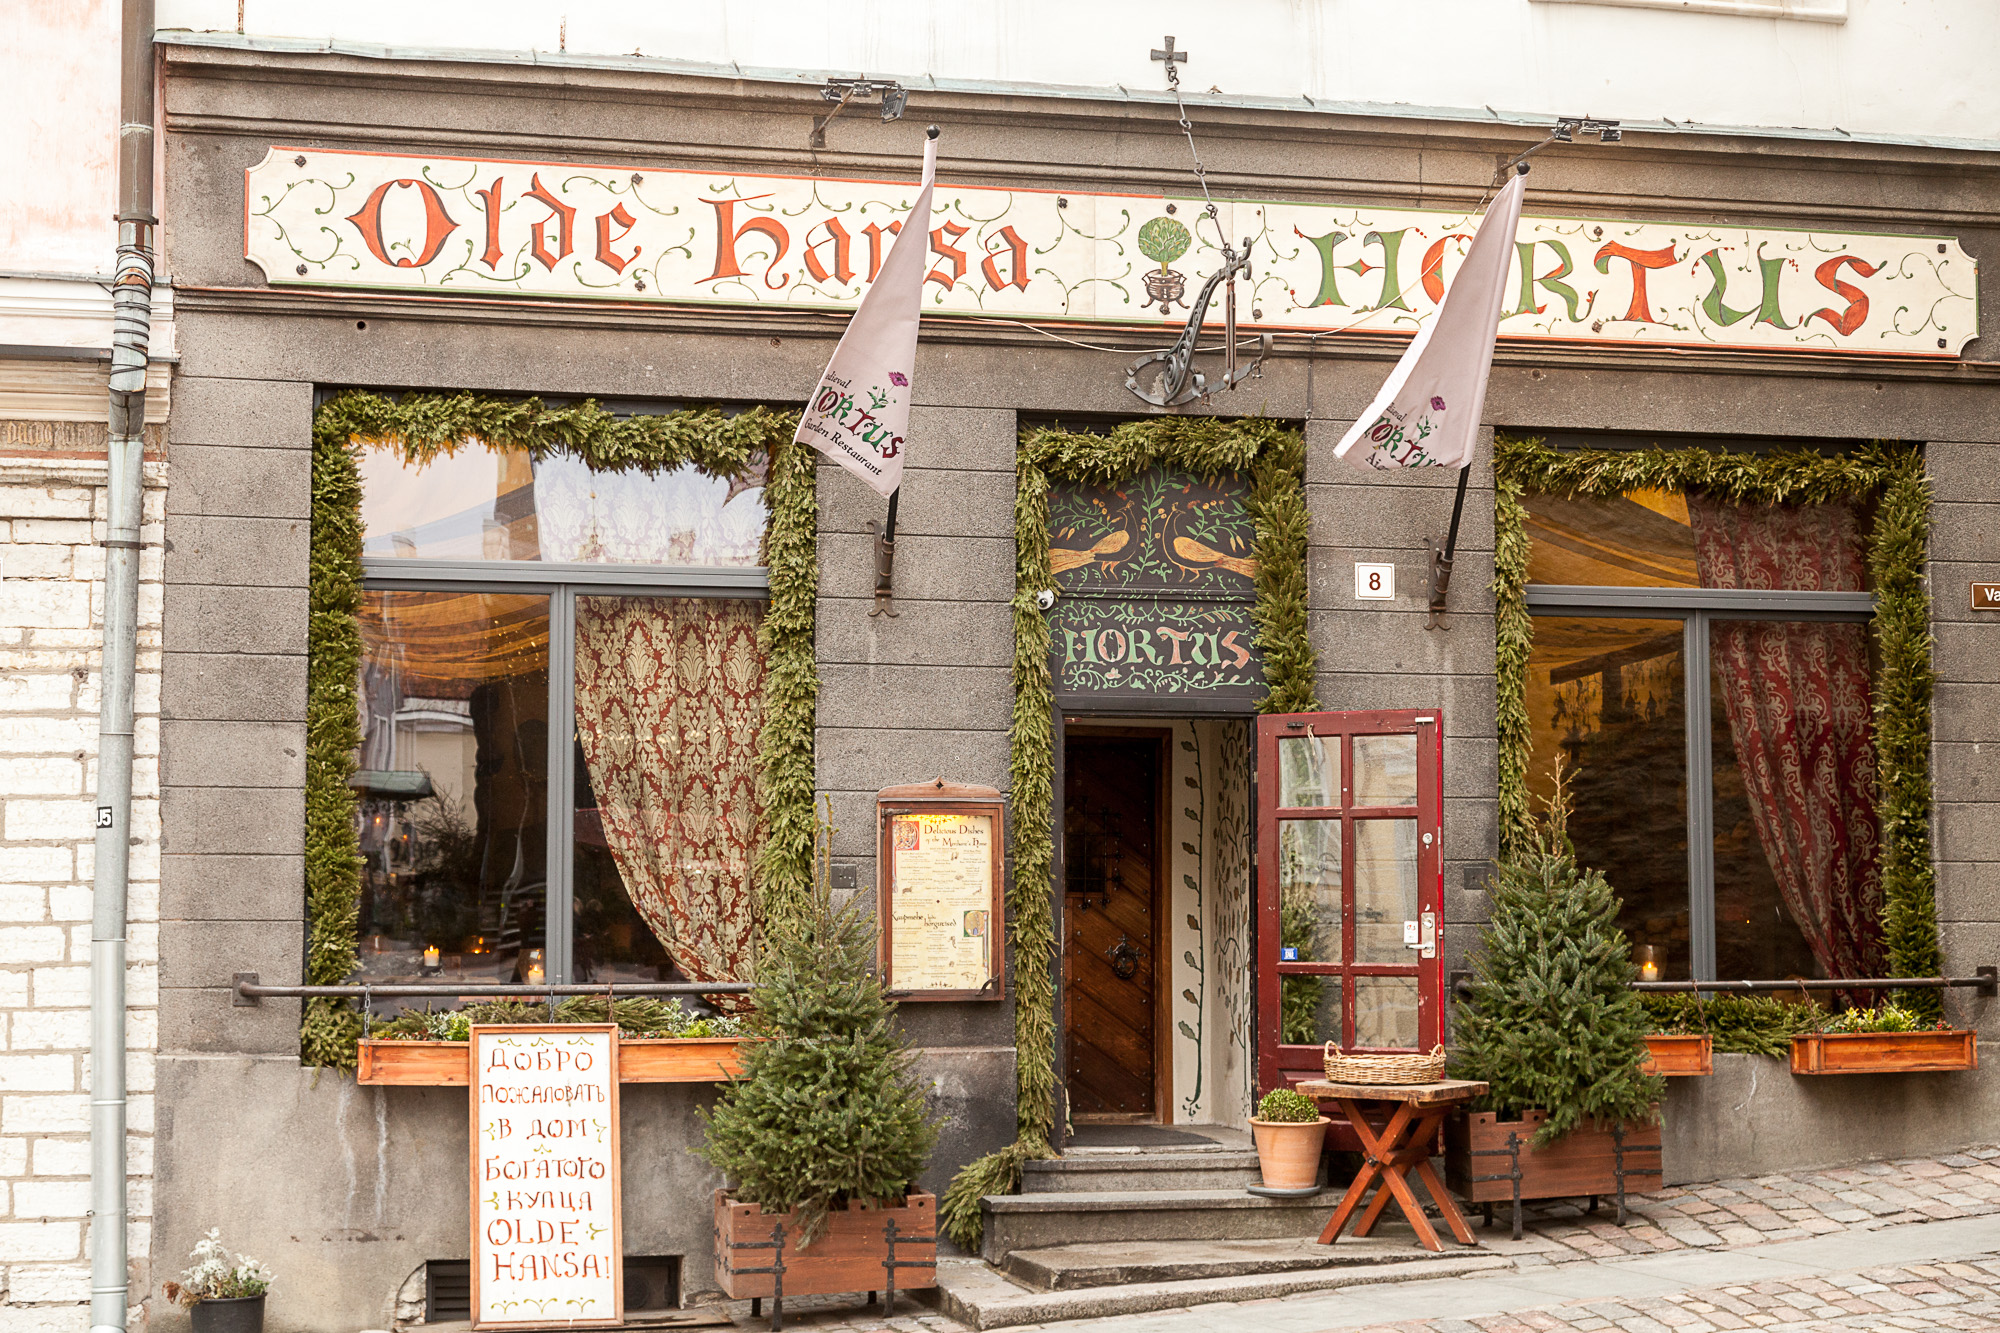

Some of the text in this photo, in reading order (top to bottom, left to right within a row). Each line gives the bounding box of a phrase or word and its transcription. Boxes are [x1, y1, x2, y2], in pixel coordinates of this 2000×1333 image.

[344, 171, 642, 276] Olde
[804, 418, 883, 476] Garden Restaurant
[1369, 572, 1381, 591] 8
[1061, 621, 1250, 672] HORTUS
[959, 824, 984, 835] Dishes
[487, 1047, 594, 1073] ДОБРО
[481, 1083, 606, 1104] ПОЖАЛОВАТЬ
[498, 1118, 587, 1140] В ДОМ
[485, 1155, 606, 1182] БОГАТОГО
[507, 1190, 593, 1212] КУПЦА
[487, 1218, 580, 1246] OLDE
[492, 1251, 611, 1283] HANSA!
